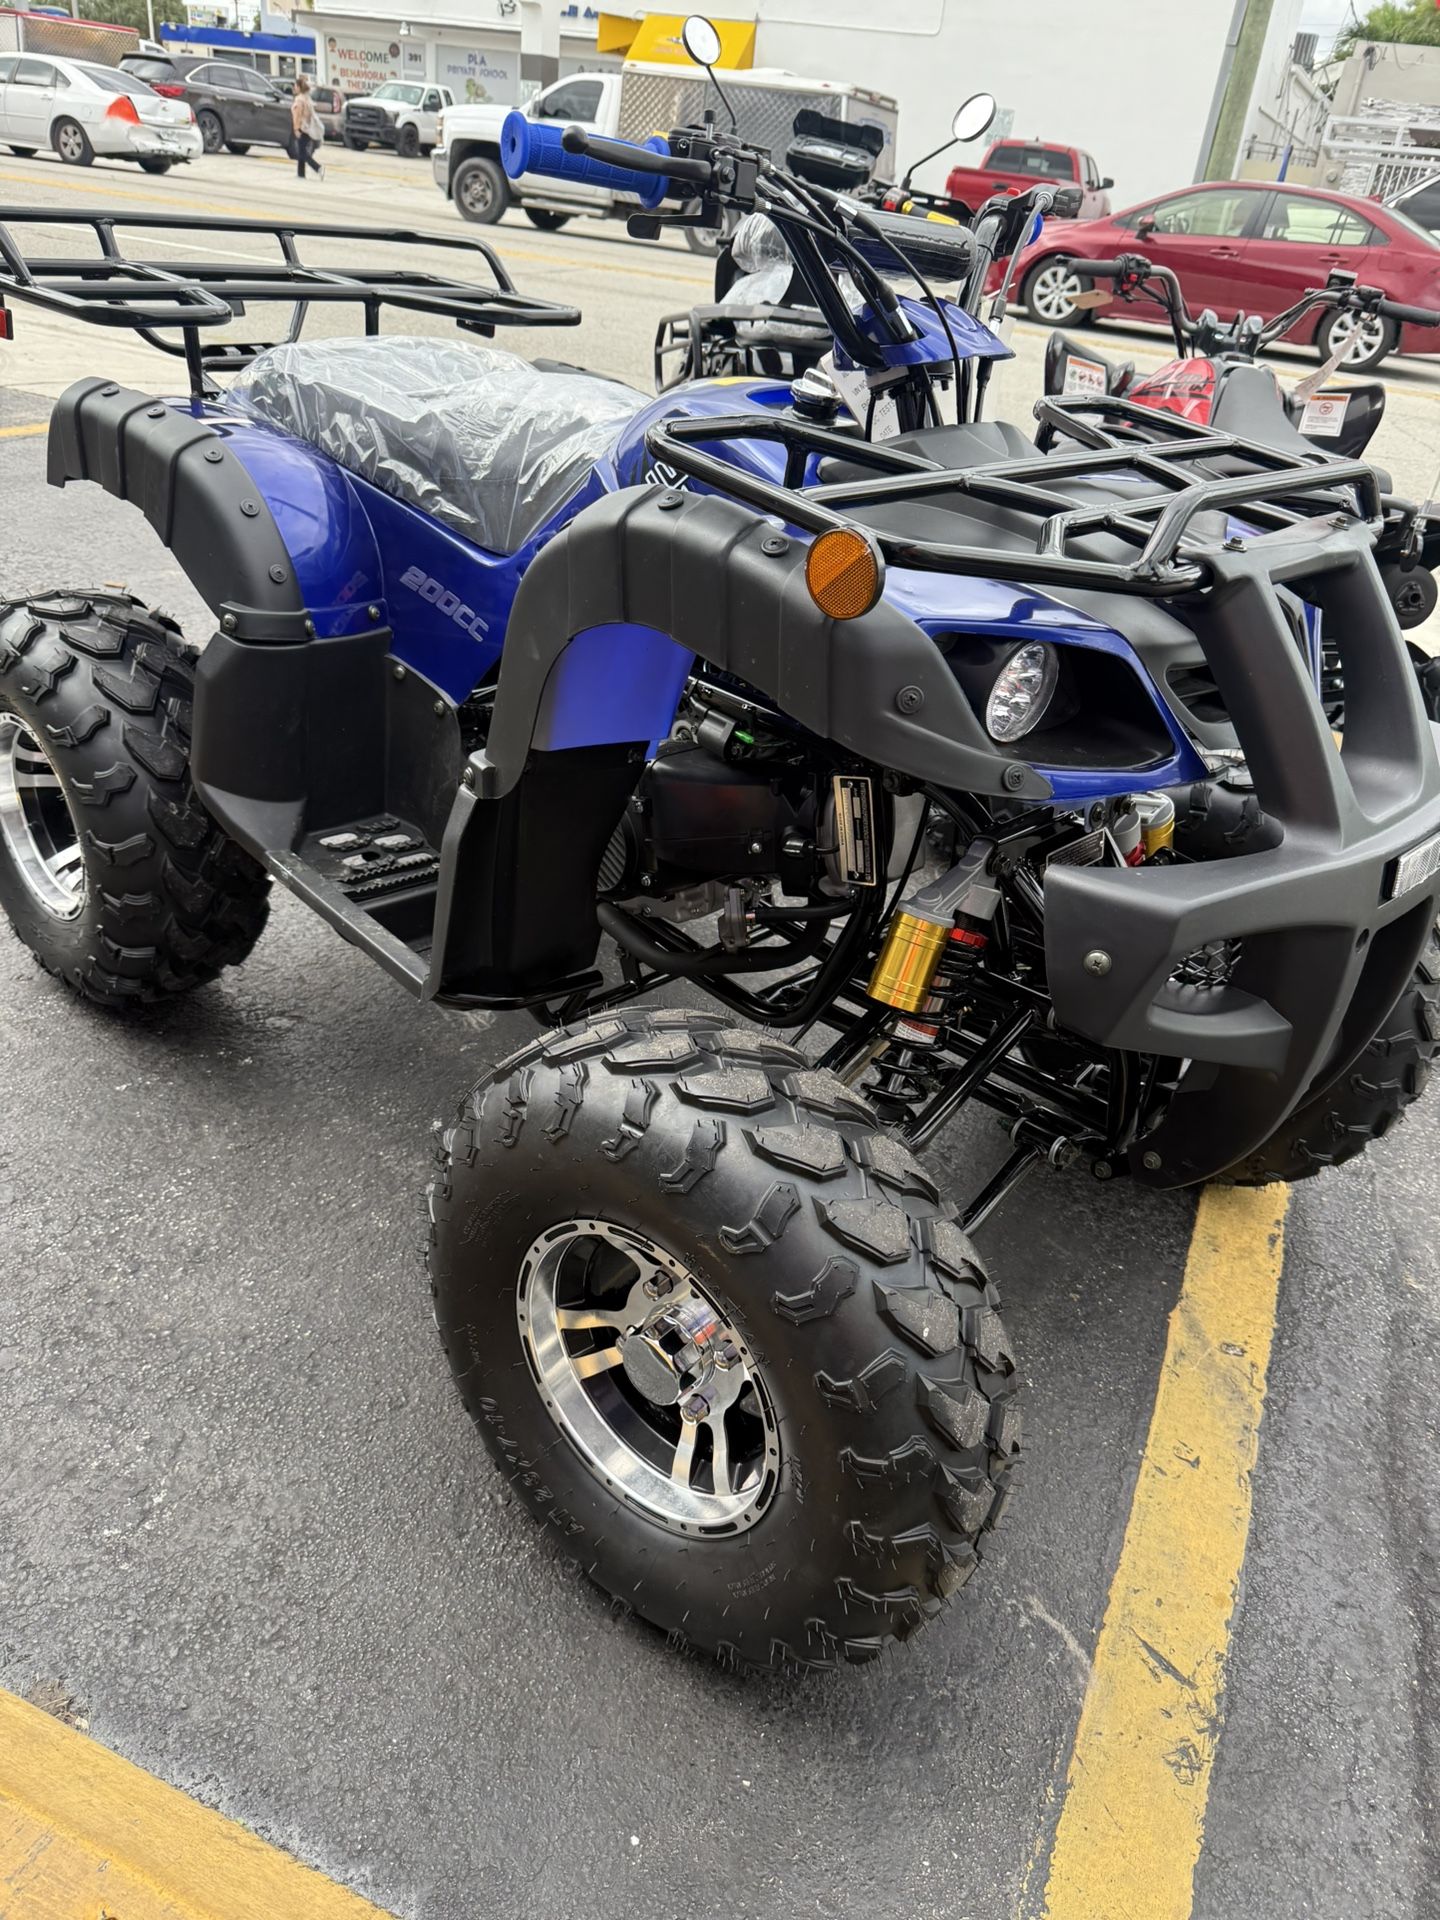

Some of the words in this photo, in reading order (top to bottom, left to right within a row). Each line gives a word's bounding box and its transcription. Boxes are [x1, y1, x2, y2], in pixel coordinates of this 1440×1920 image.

[338, 48, 389, 64] WELCOME
[408, 53, 422, 63] 391
[468, 53, 487, 66] PLA
[340, 67, 387, 81] BEHAVIORAL
[447, 64, 476, 77] PRIVATE
[479, 67, 508, 80] SCHOOL
[399, 565, 489, 642] 200CC
